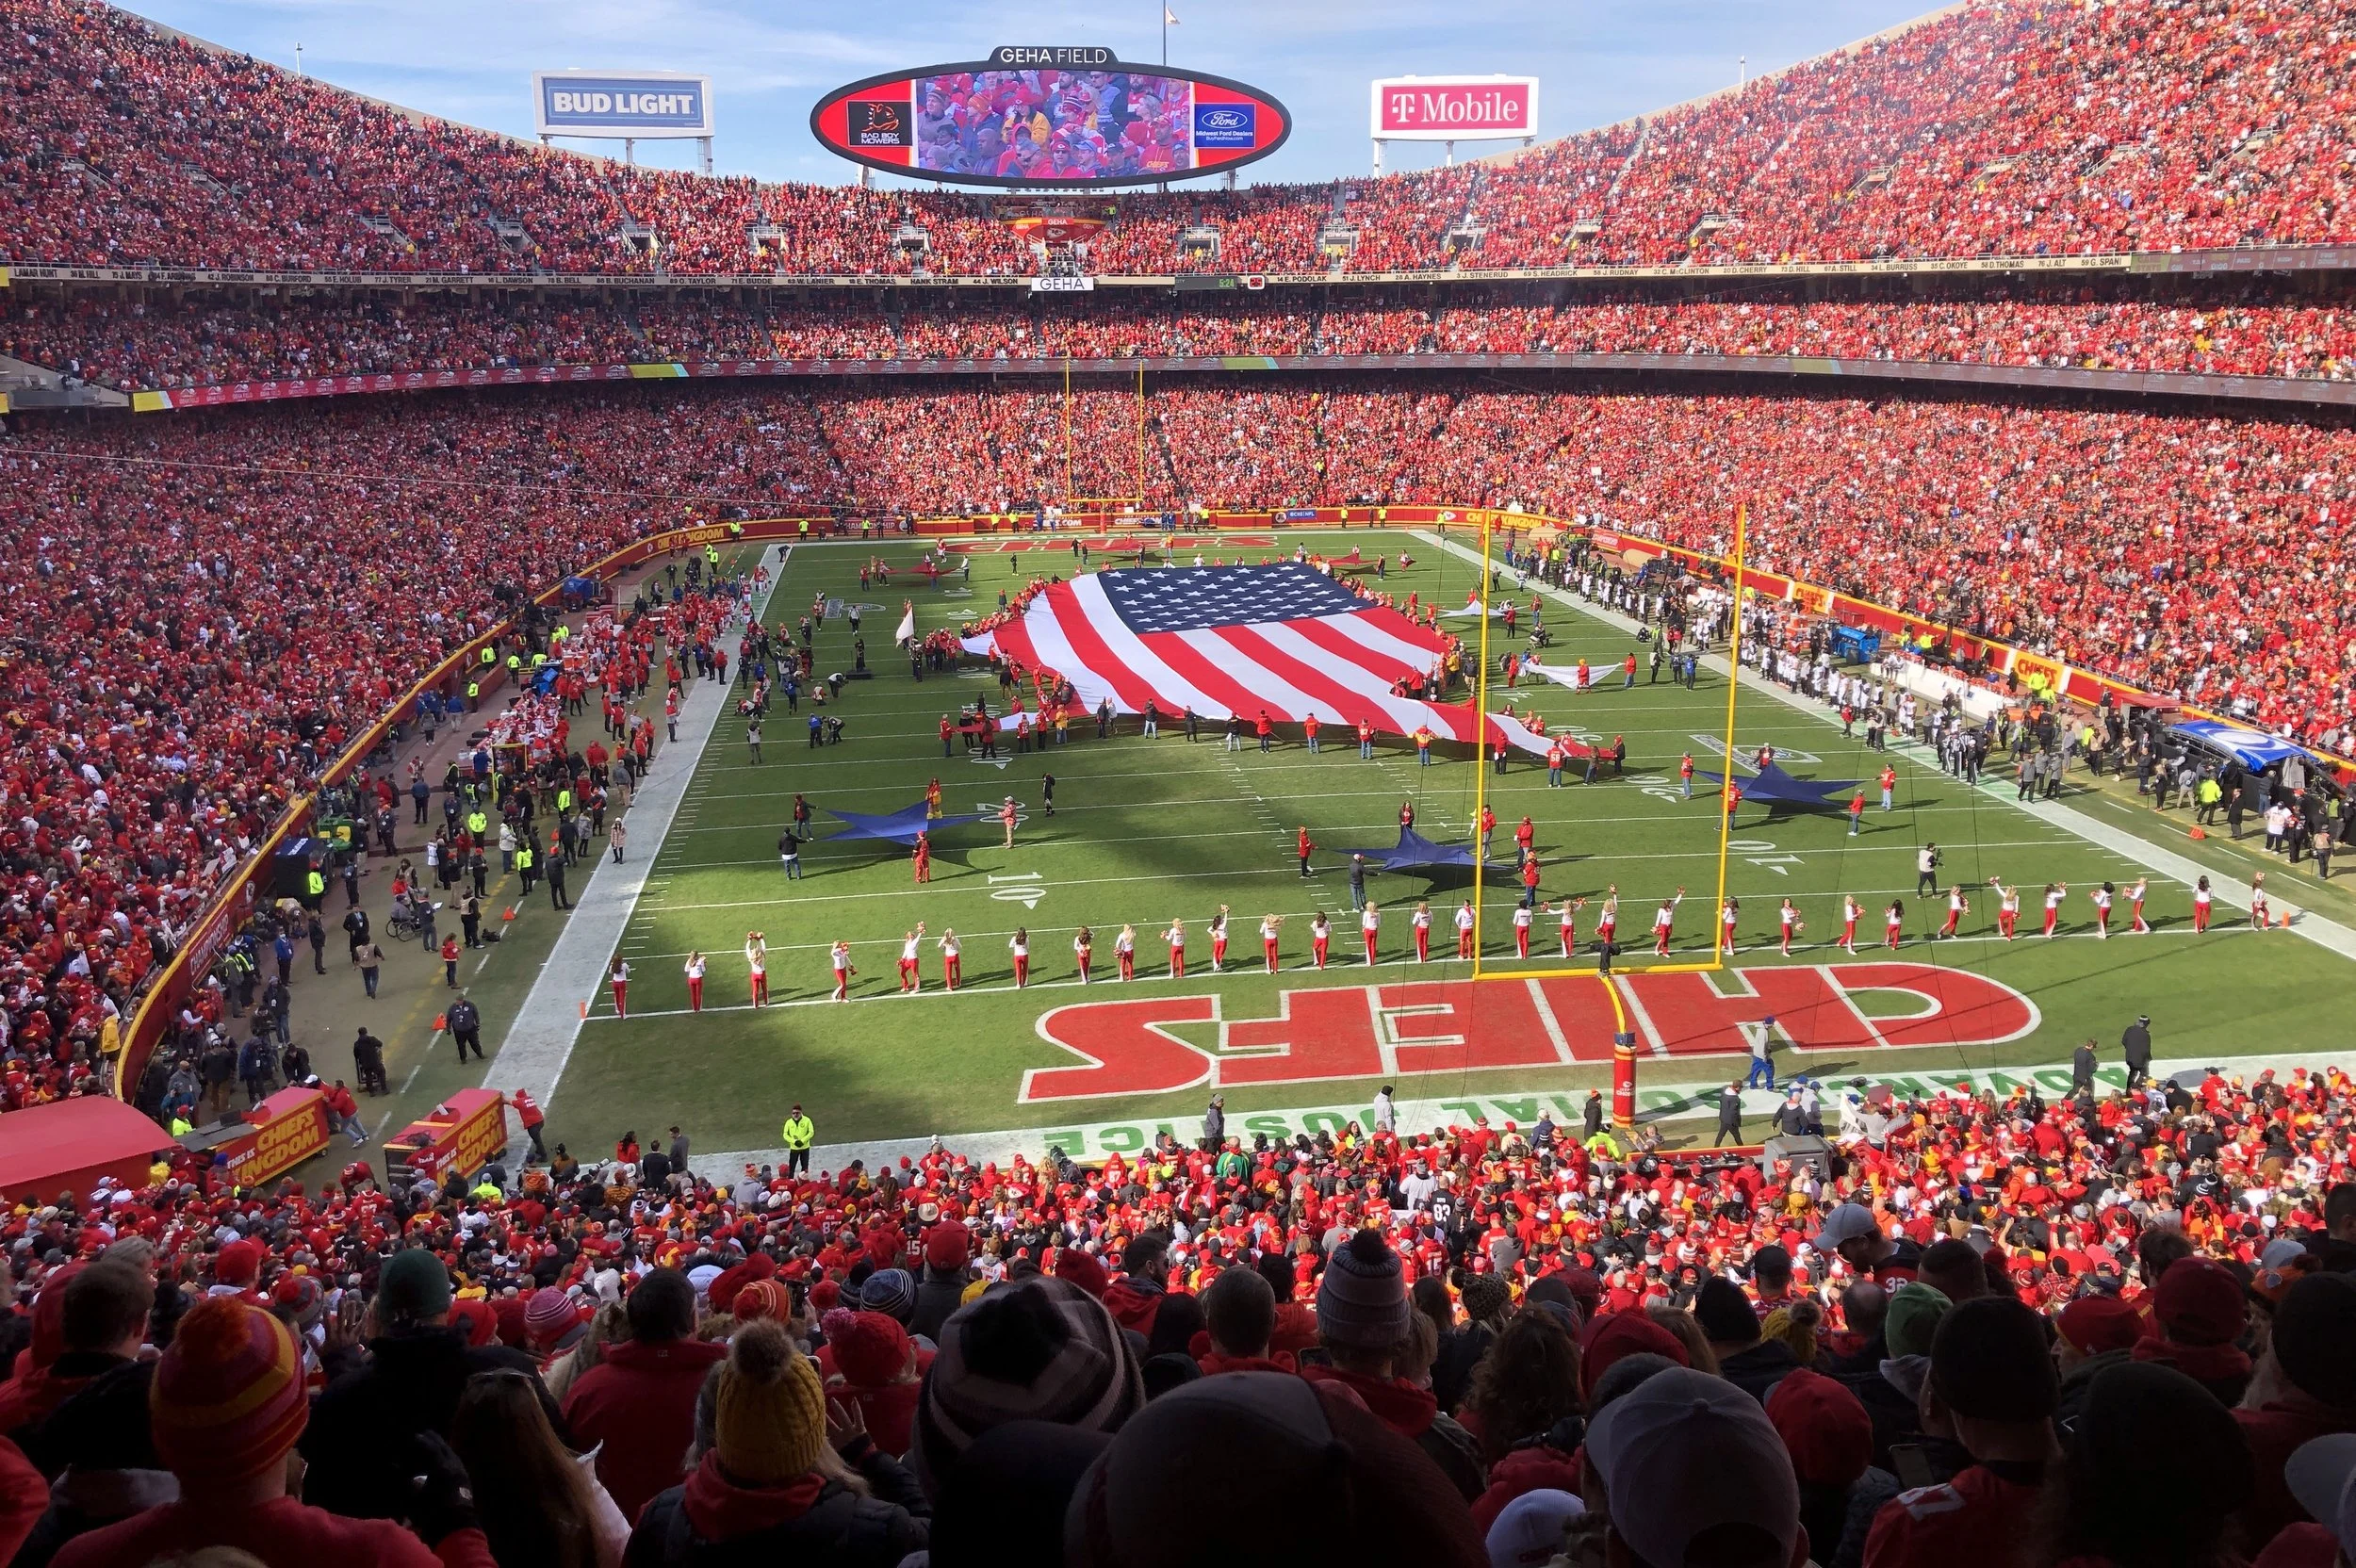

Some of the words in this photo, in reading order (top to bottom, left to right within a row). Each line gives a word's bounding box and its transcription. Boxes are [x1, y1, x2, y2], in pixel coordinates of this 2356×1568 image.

[1000, 48, 1052, 63] GEHA
[1057, 48, 1107, 63] FIELD
[553, 92, 612, 113] BUD
[615, 94, 694, 115] LIGHT
[1421, 92, 1519, 122] Mobile
[1210, 113, 1239, 126] Ford
[1886, 263, 1918, 271] BURRUSS
[1996, 260, 2024, 269] THOMAS
[2053, 259, 2067, 268] ALT
[2099, 257, 2121, 267] SPANI
[1039, 278, 1085, 290] GEHA
[1219, 278, 1235, 288] 5:24
[987, 872, 1047, 901] 10
[1017, 962, 2043, 1104] CHIEFS
[1439, 1086, 1746, 1124] SOIAL
[256, 1106, 317, 1152] CHIEFS
[458, 1104, 499, 1150] CHIEFS
[227, 1155, 245, 1169] THIS
[246, 1148, 255, 1159] IS
[435, 1154, 450, 1170] THIS
[450, 1147, 457, 1158] IS
[436, 1125, 503, 1190] KNGDOM
[1433, 1204, 1451, 1222] 83
[906, 1239, 921, 1255] 15
[1426, 1259, 1443, 1277] 15
